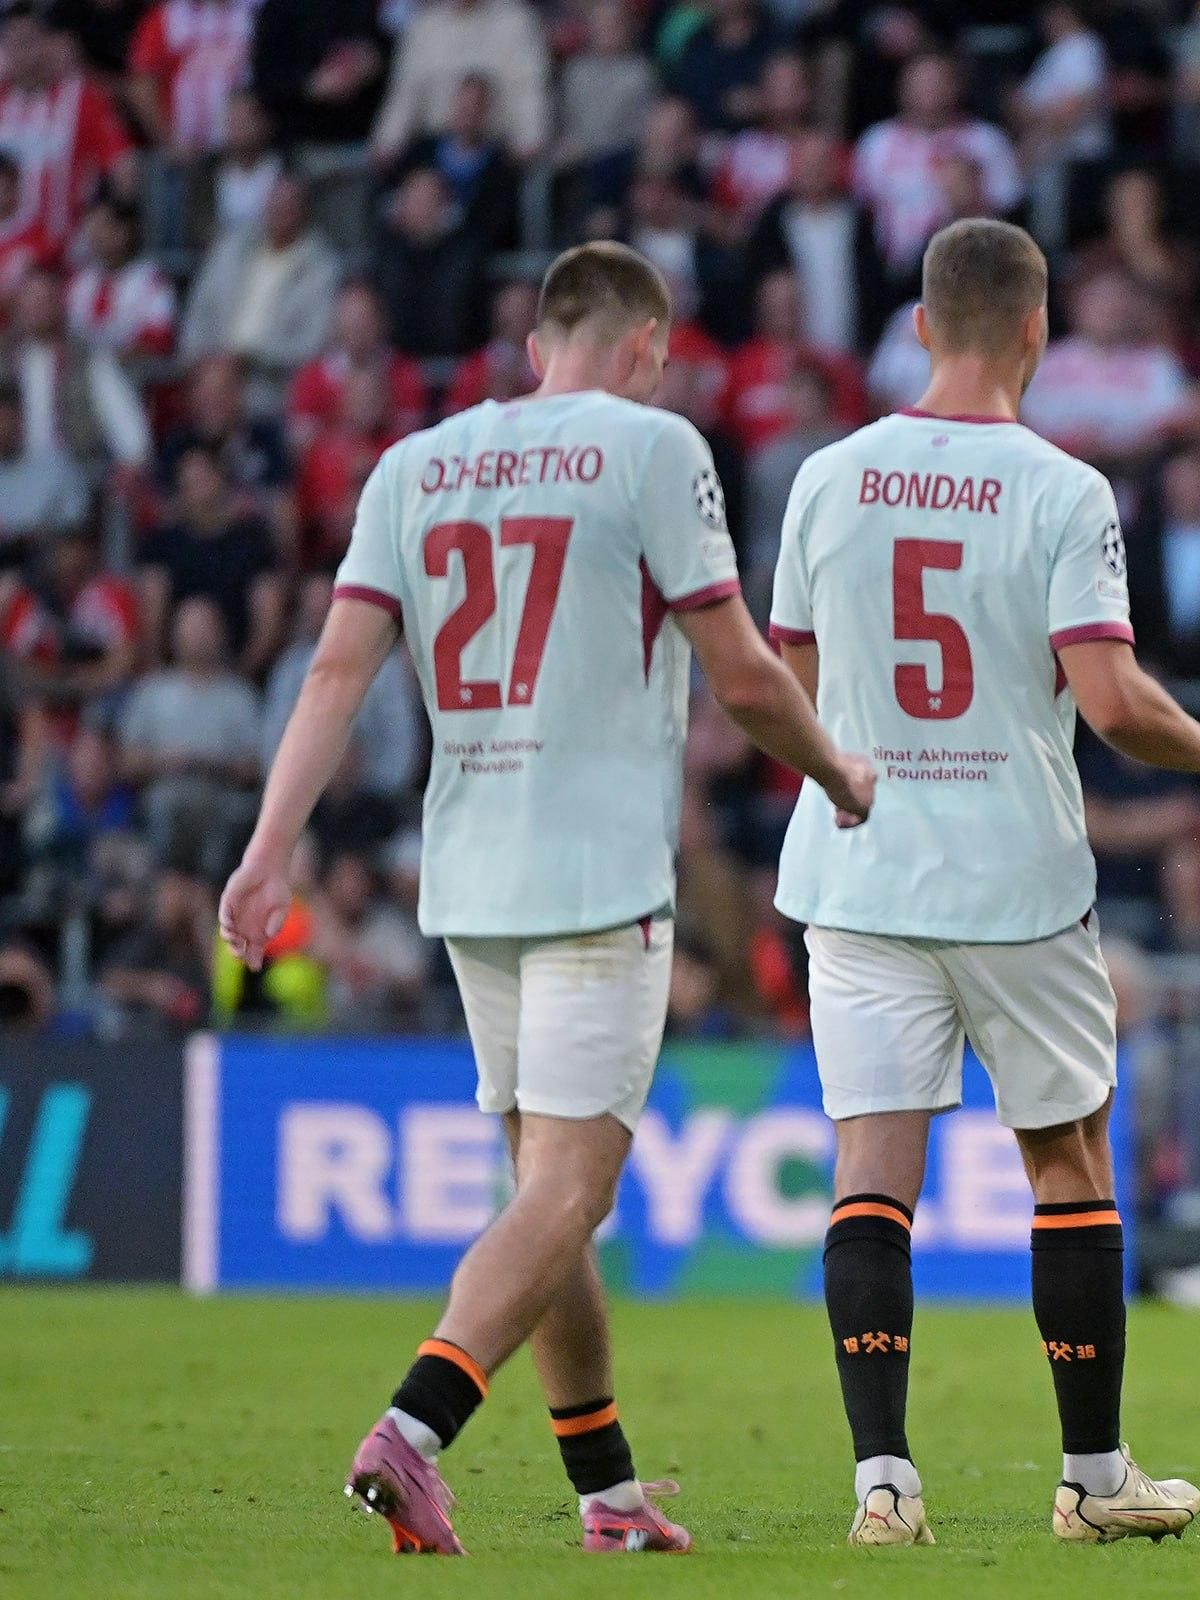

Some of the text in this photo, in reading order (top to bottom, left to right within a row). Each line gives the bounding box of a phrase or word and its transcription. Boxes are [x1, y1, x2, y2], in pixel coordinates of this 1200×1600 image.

[859, 467, 1003, 515] BONDAR
[423, 516, 575, 712] 27
[893, 537, 974, 720] 5
[887, 765, 988, 781] Foundation
[919, 747, 1009, 762] Akhmetov
[0, 1082, 92, 1276] L
[278, 1103, 1036, 1250] REYCE
